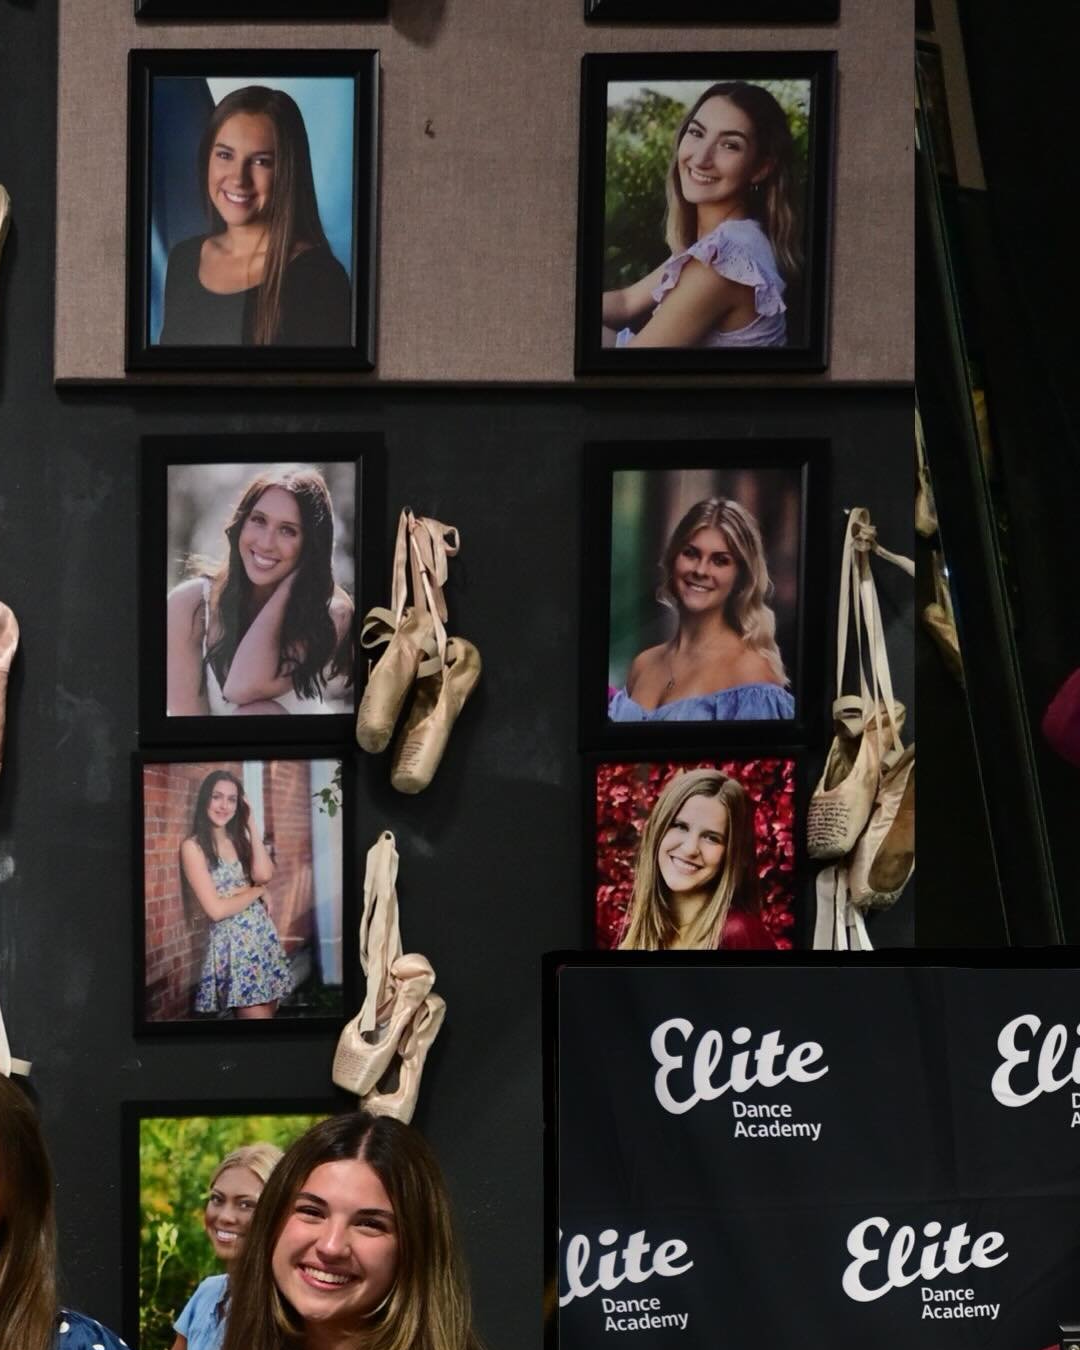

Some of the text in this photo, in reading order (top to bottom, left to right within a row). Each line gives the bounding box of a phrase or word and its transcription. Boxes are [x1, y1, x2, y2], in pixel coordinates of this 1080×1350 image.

[651, 1018, 829, 1115] Elite
[732, 1101, 793, 1118] Dance
[734, 1119, 822, 1142] Academy
[559, 1228, 694, 1308] lite
[842, 1217, 1009, 1302] Elite
[921, 1287, 975, 1302] Dance
[602, 1298, 661, 1314] Dance
[922, 1302, 1001, 1321] Academy
[604, 1312, 689, 1332] Academy
